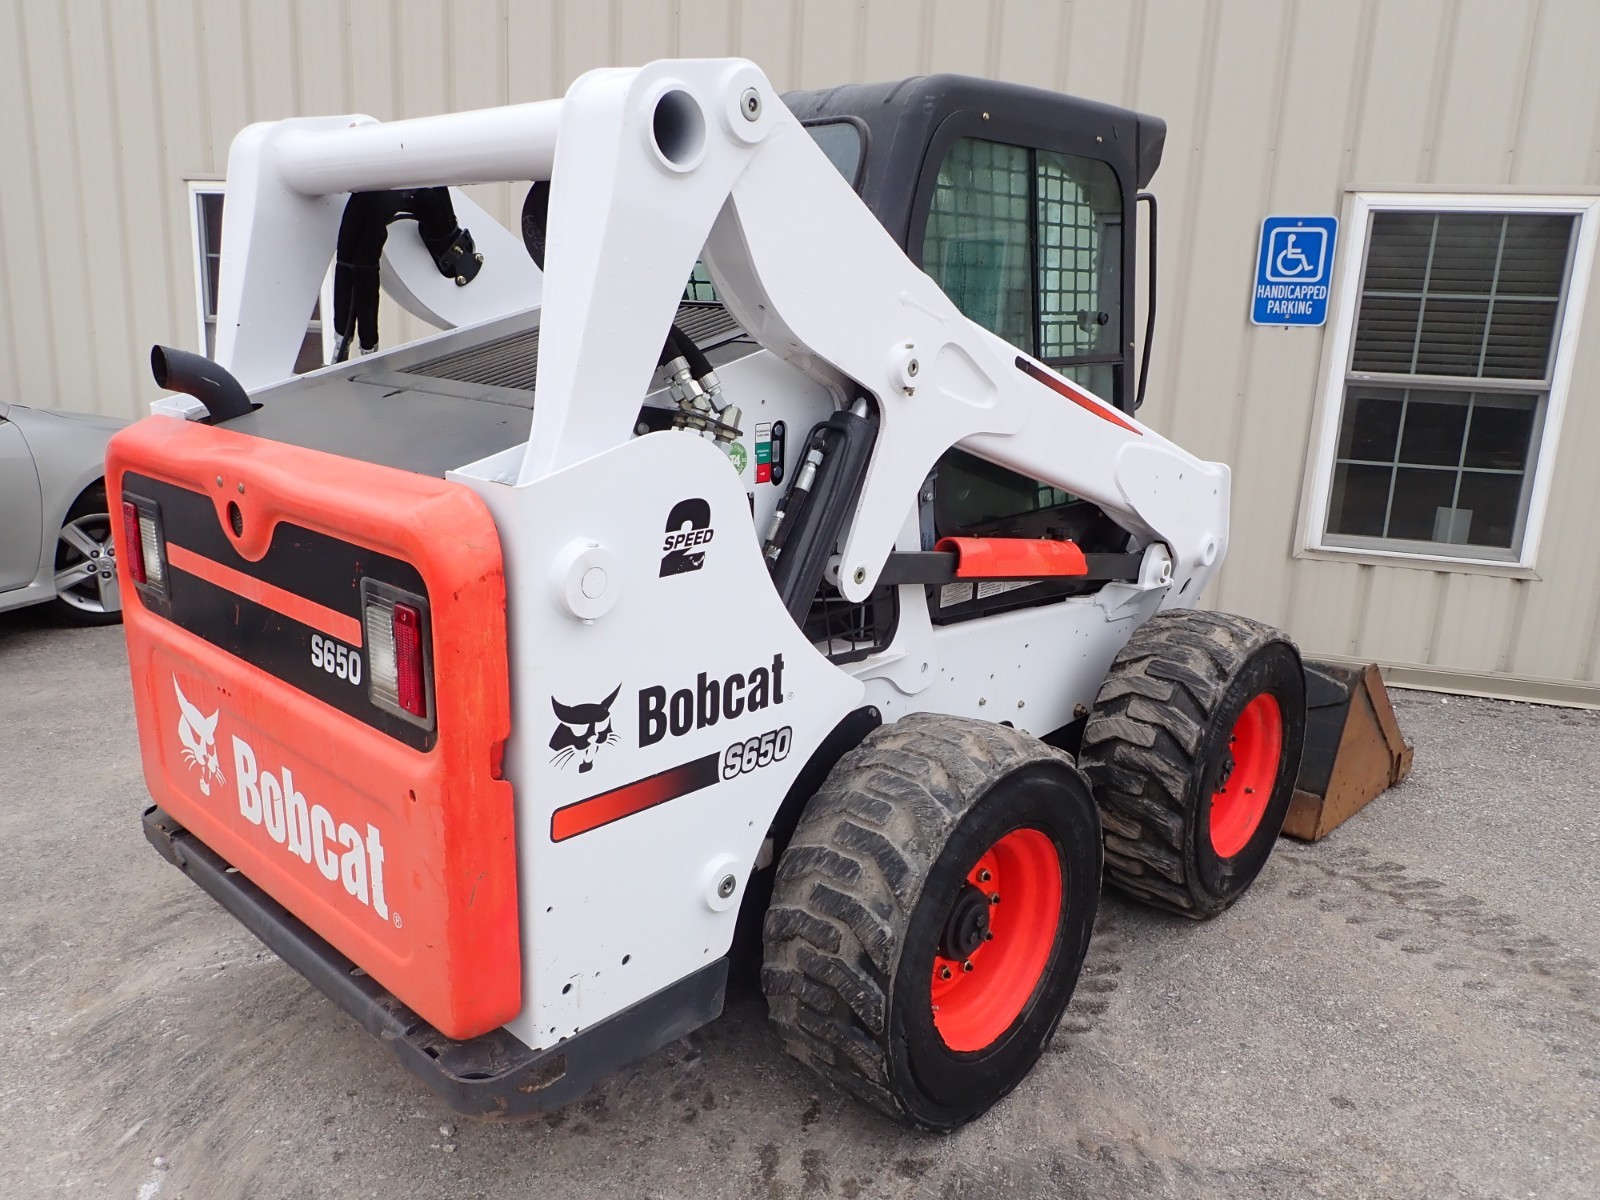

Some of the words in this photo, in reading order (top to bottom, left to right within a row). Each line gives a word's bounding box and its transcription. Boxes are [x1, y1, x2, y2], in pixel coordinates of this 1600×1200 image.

[1257, 285, 1327, 299] HANDICAPPED
[1266, 300, 1313, 314] PARKING
[663, 529, 714, 551] SPEED
[311, 634, 361, 685] S650
[639, 653, 784, 748] Bobcat
[723, 725, 793, 780] S650
[232, 735, 388, 920] Bobcat
